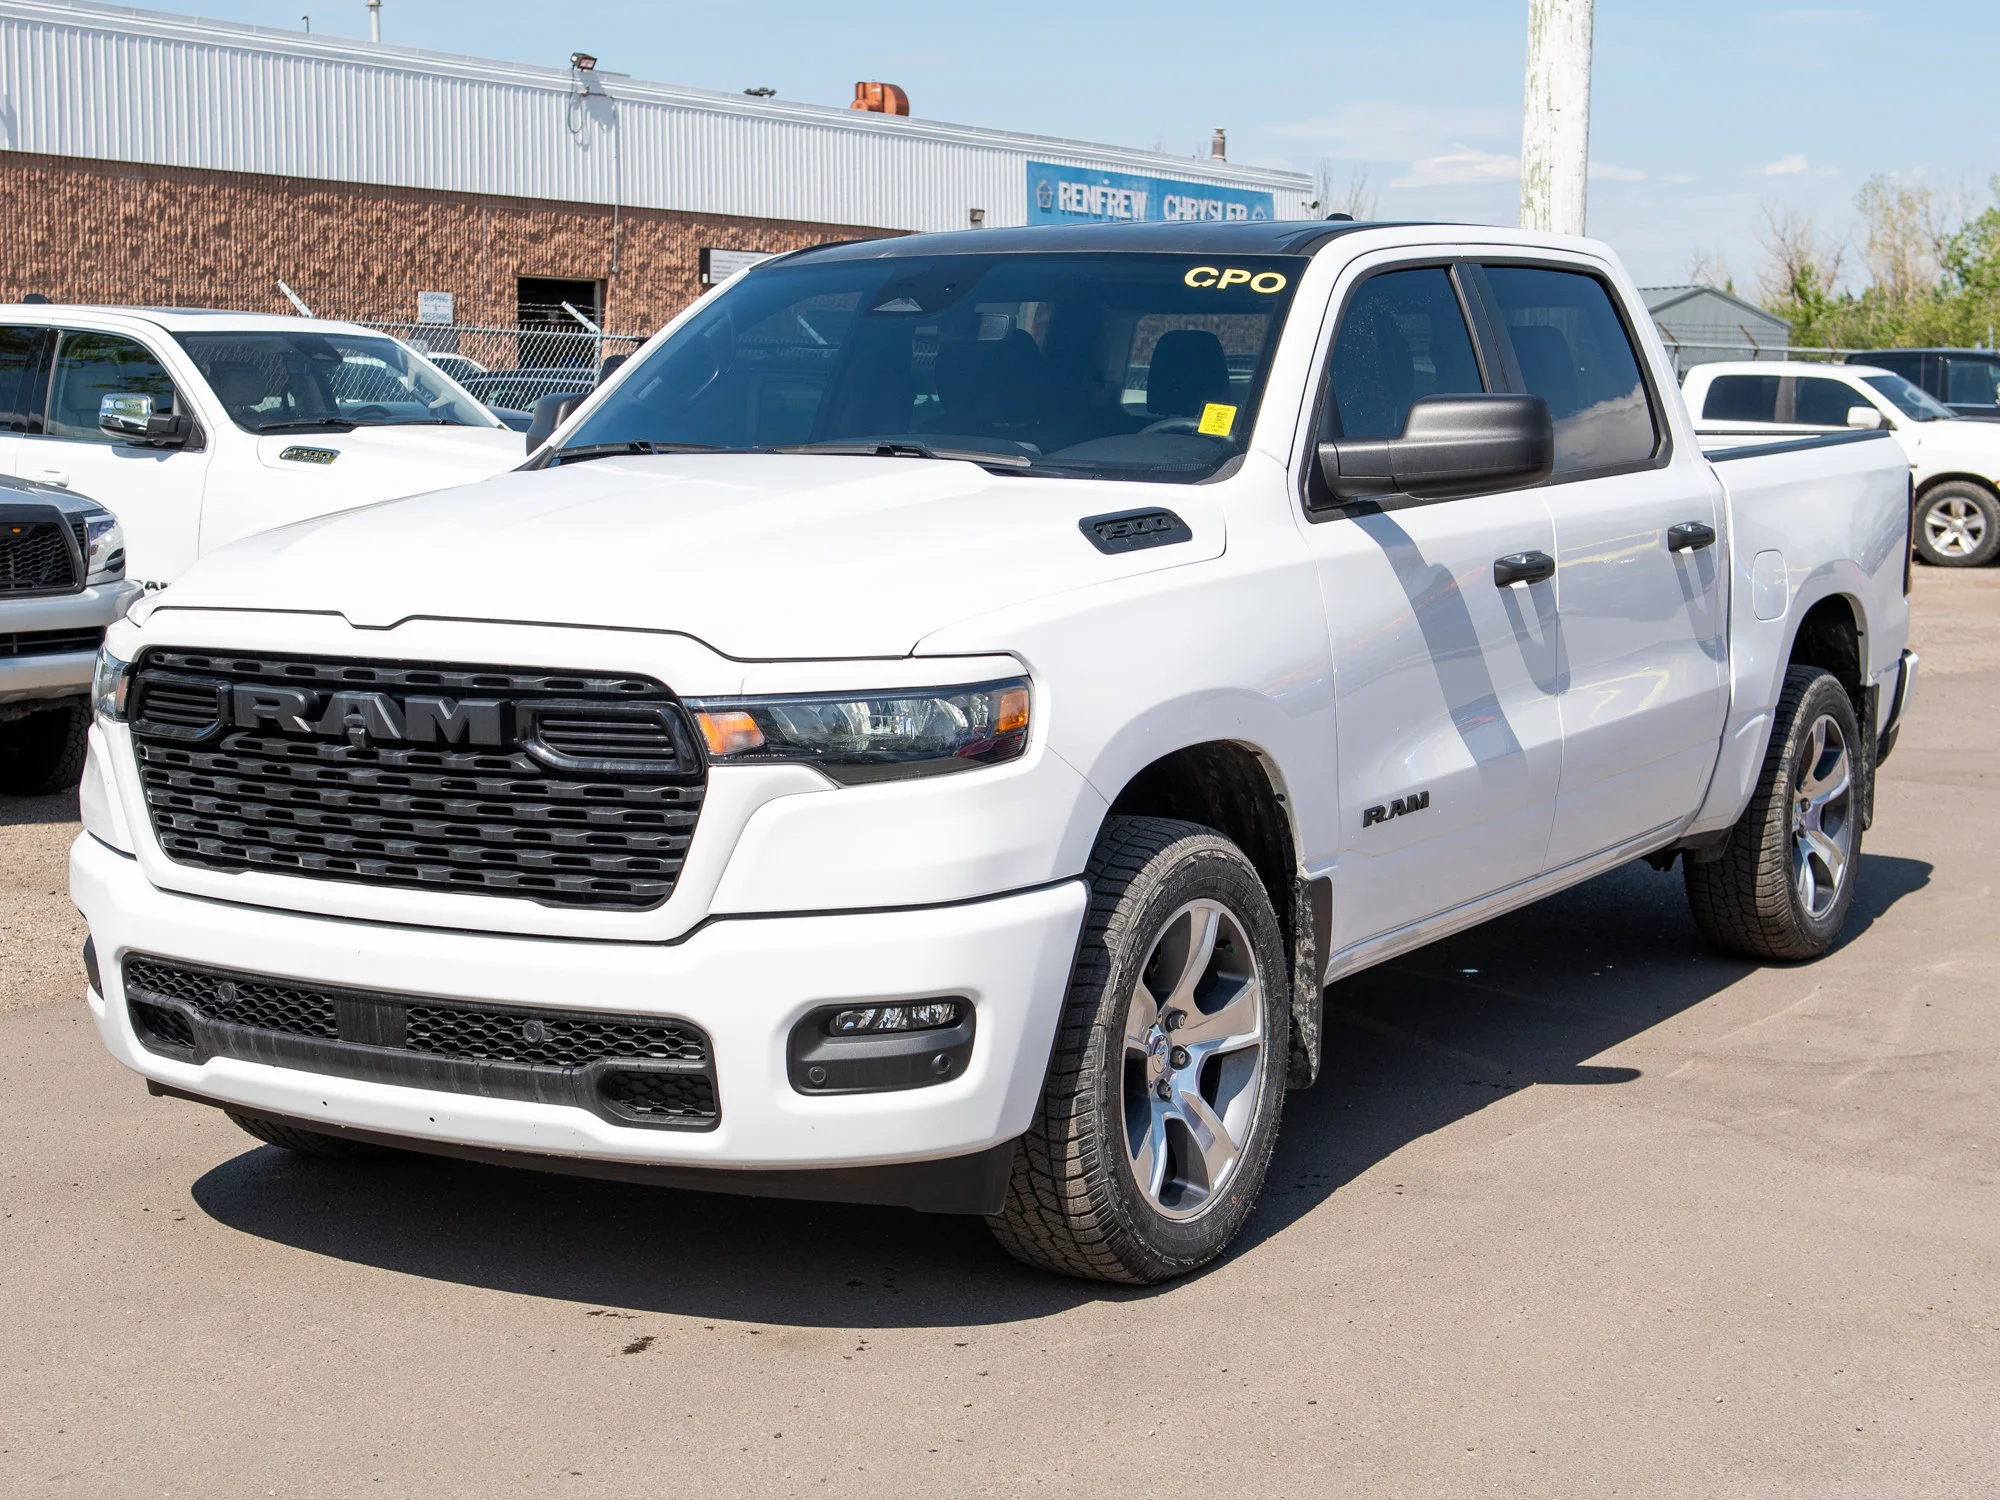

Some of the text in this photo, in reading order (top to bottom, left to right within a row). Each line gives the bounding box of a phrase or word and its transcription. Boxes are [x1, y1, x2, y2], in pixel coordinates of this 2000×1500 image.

[1058, 182, 1147, 220] RENFREW
[1184, 266, 1287, 294] CPO
[1094, 513, 1172, 541] 1500
[233, 682, 509, 746] RAM
[1362, 790, 1429, 828] RAM
